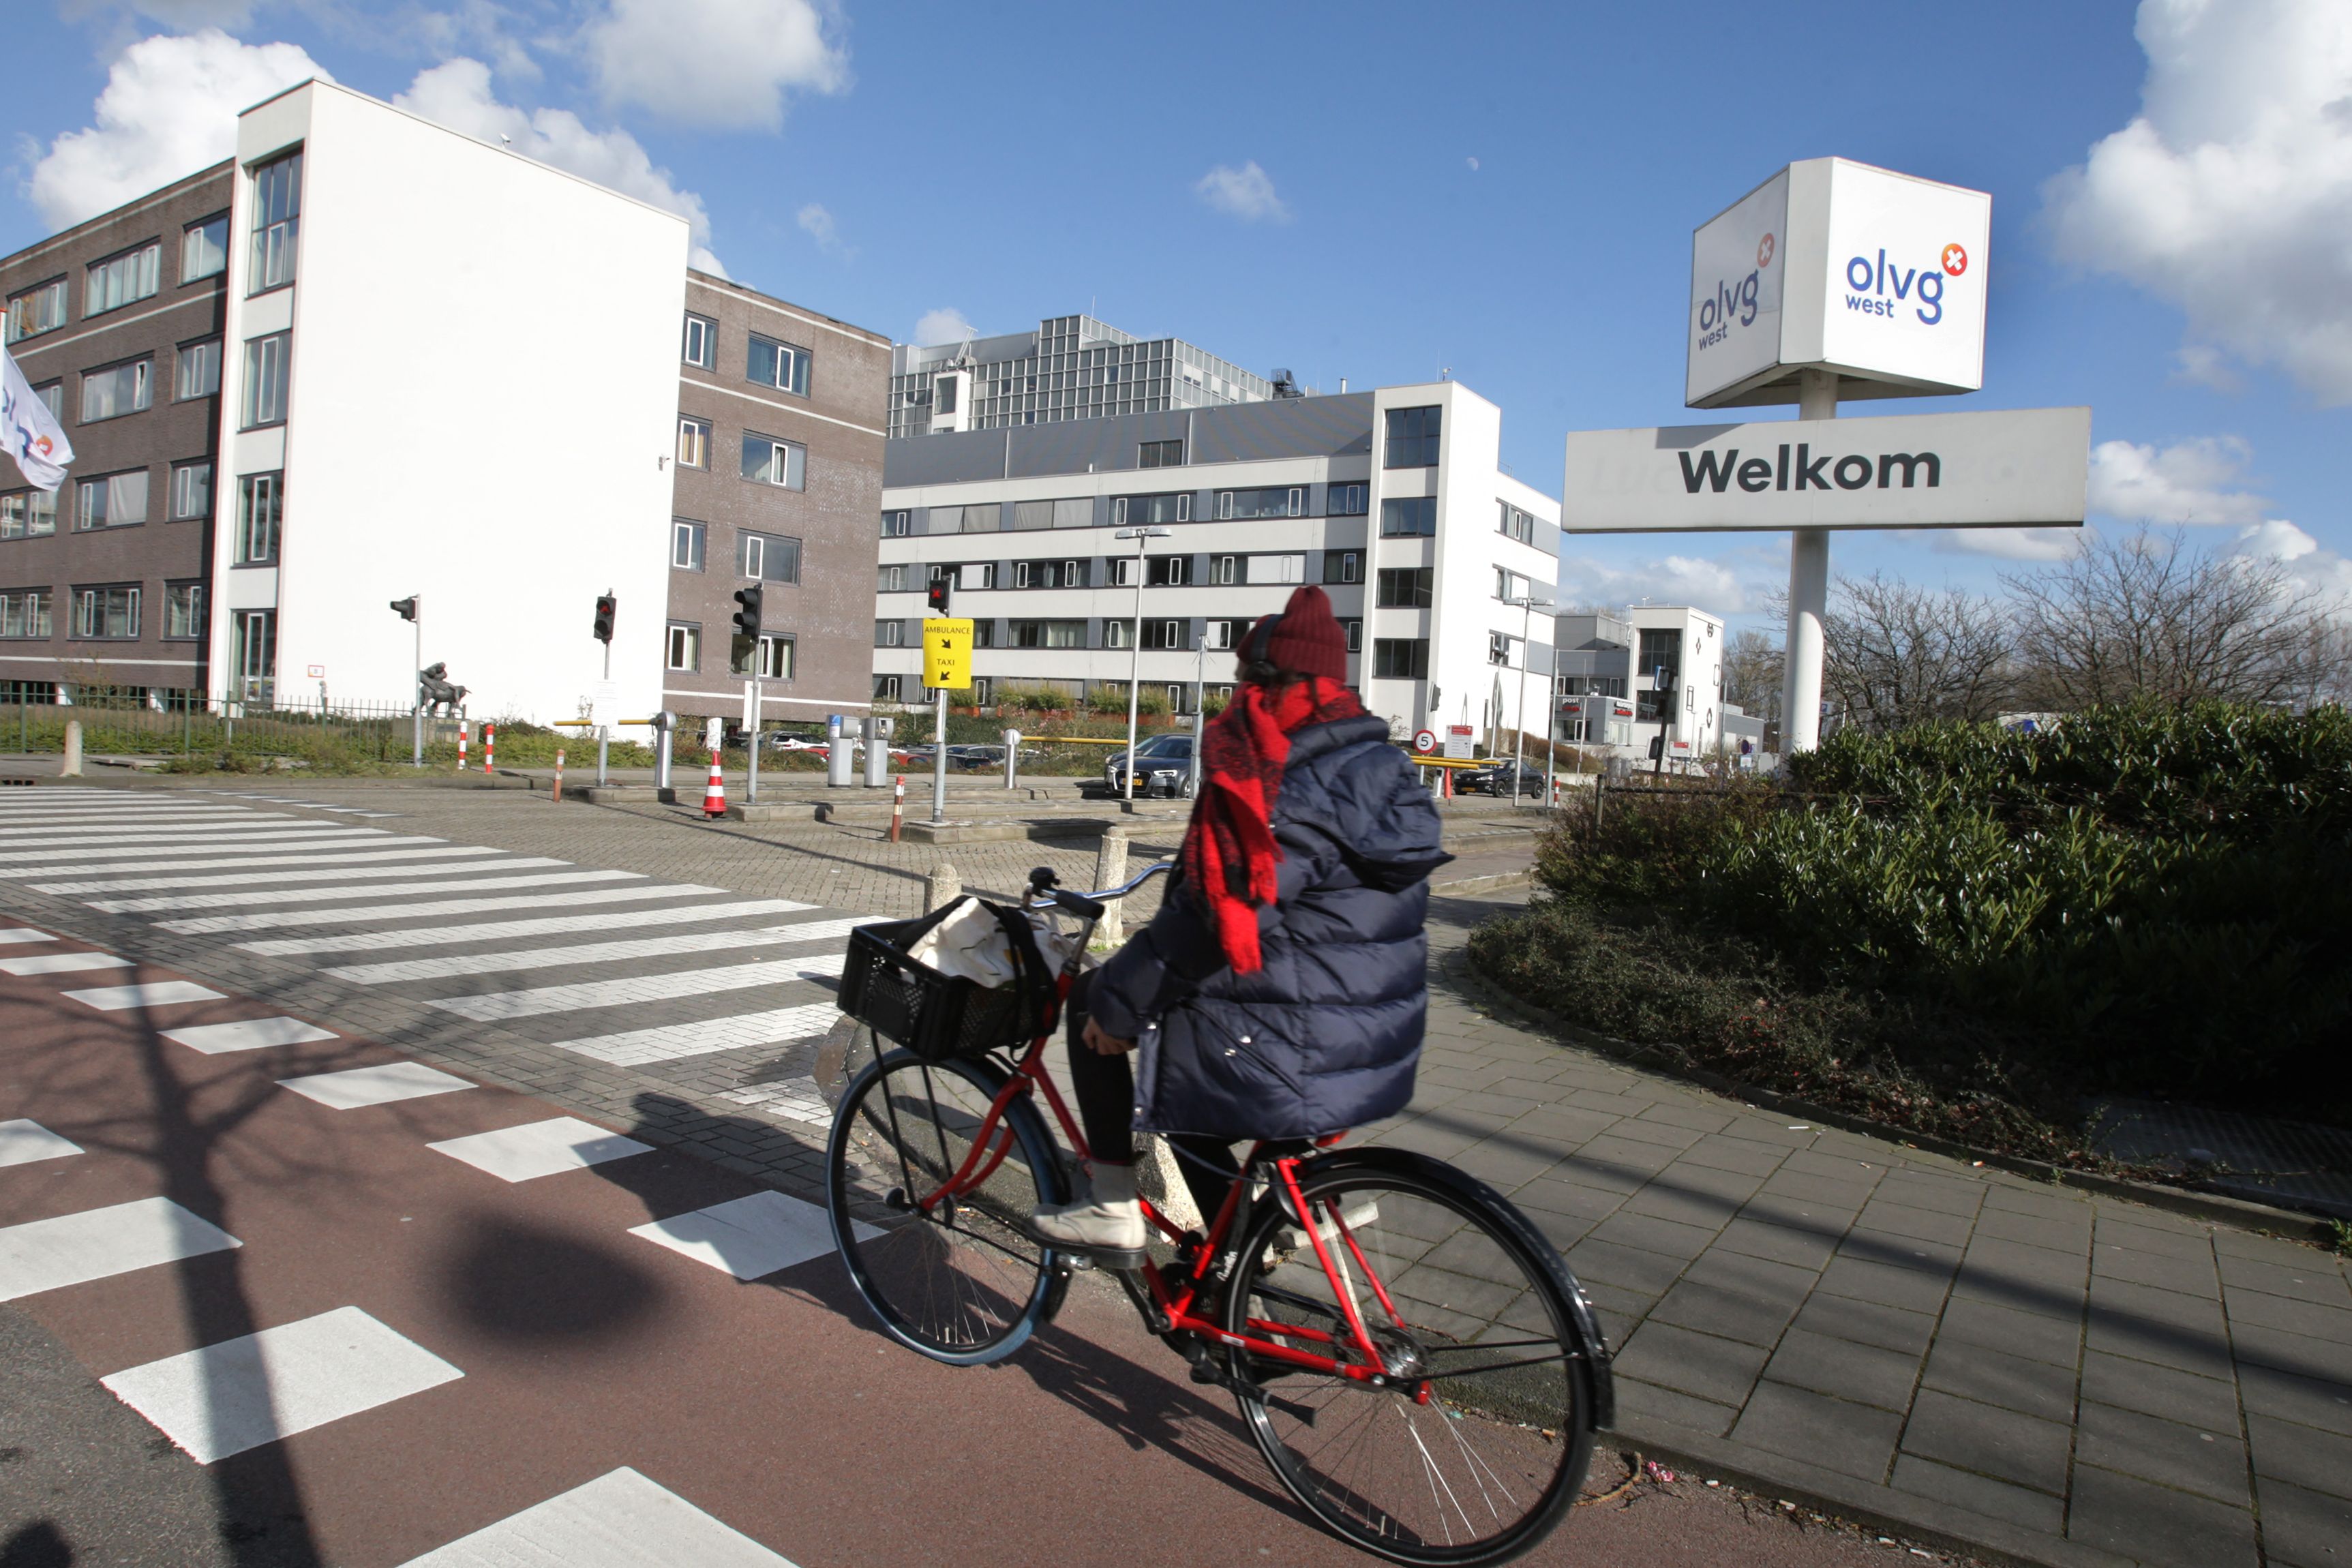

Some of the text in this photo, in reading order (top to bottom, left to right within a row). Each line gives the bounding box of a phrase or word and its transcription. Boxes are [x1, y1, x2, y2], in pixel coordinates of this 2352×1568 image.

[1700, 269, 1759, 331] olvg
[1845, 295, 1895, 318] west
[1847, 248, 1944, 325] olvg
[1698, 322, 1728, 351] west
[1678, 443, 1940, 494] Welkom
[1420, 736, 1429, 747] 5
